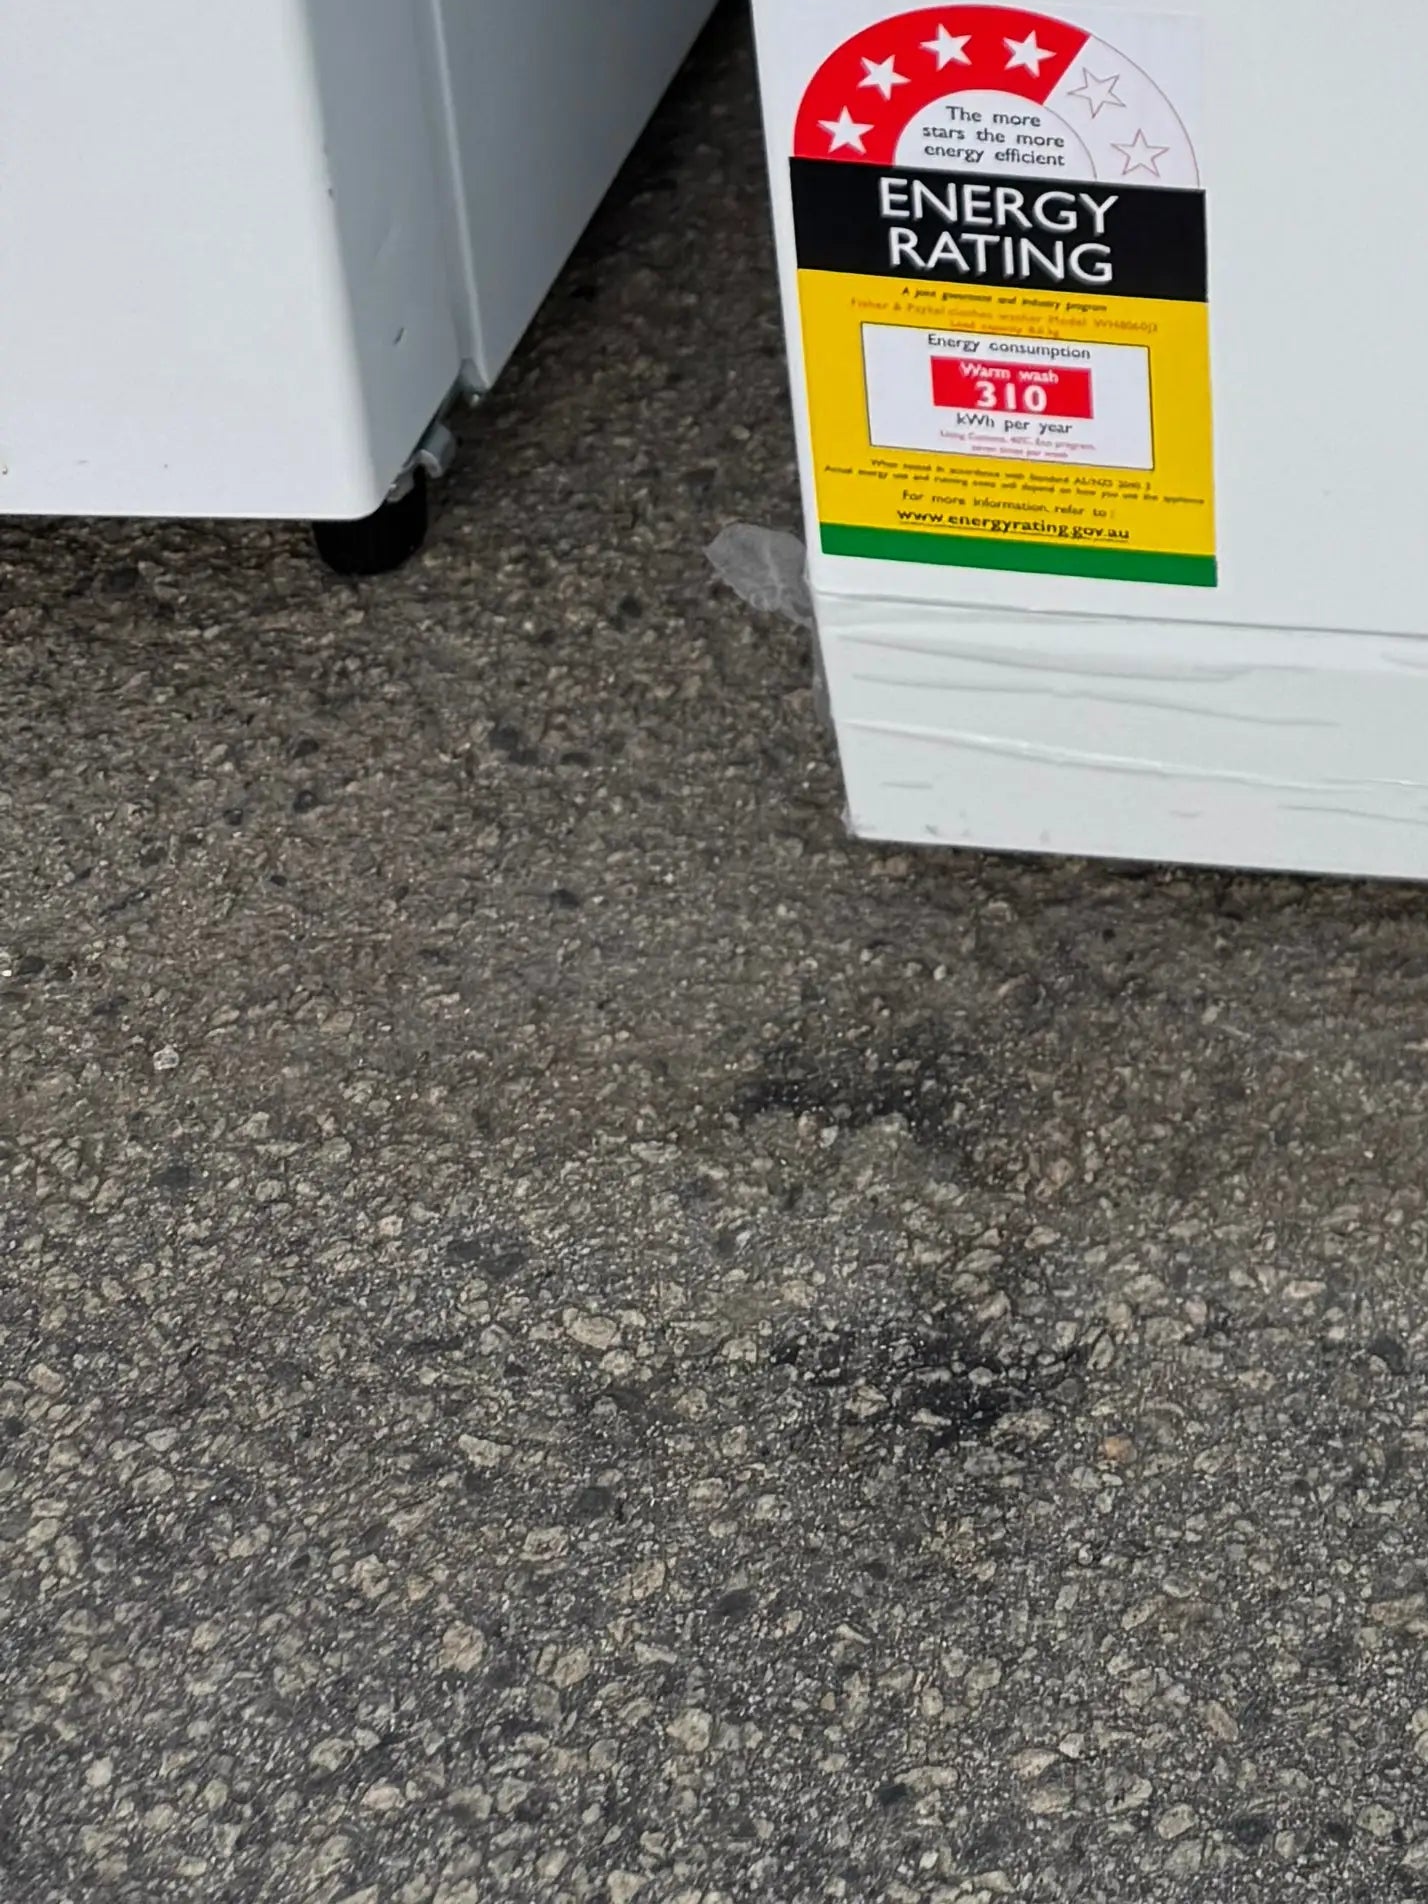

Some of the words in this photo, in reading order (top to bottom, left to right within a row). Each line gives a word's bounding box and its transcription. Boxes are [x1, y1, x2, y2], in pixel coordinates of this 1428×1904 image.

[946, 106, 981, 122] The
[993, 114, 1040, 127] more
[923, 127, 965, 140] stars
[977, 128, 1005, 143] the
[1017, 135, 1064, 147] more
[924, 146, 984, 163] energy
[995, 148, 1064, 166] efficient
[880, 177, 1119, 234] ENERGY
[889, 227, 1114, 284] RATING
[928, 334, 979, 352] Energy
[989, 343, 1090, 359] consumption
[959, 360, 1010, 381] Warm
[1019, 367, 1059, 384] wash
[976, 380, 1048, 412] 310
[957, 413, 994, 427] kWh
[1005, 420, 1030, 432] per
[1040, 423, 1072, 435] year
